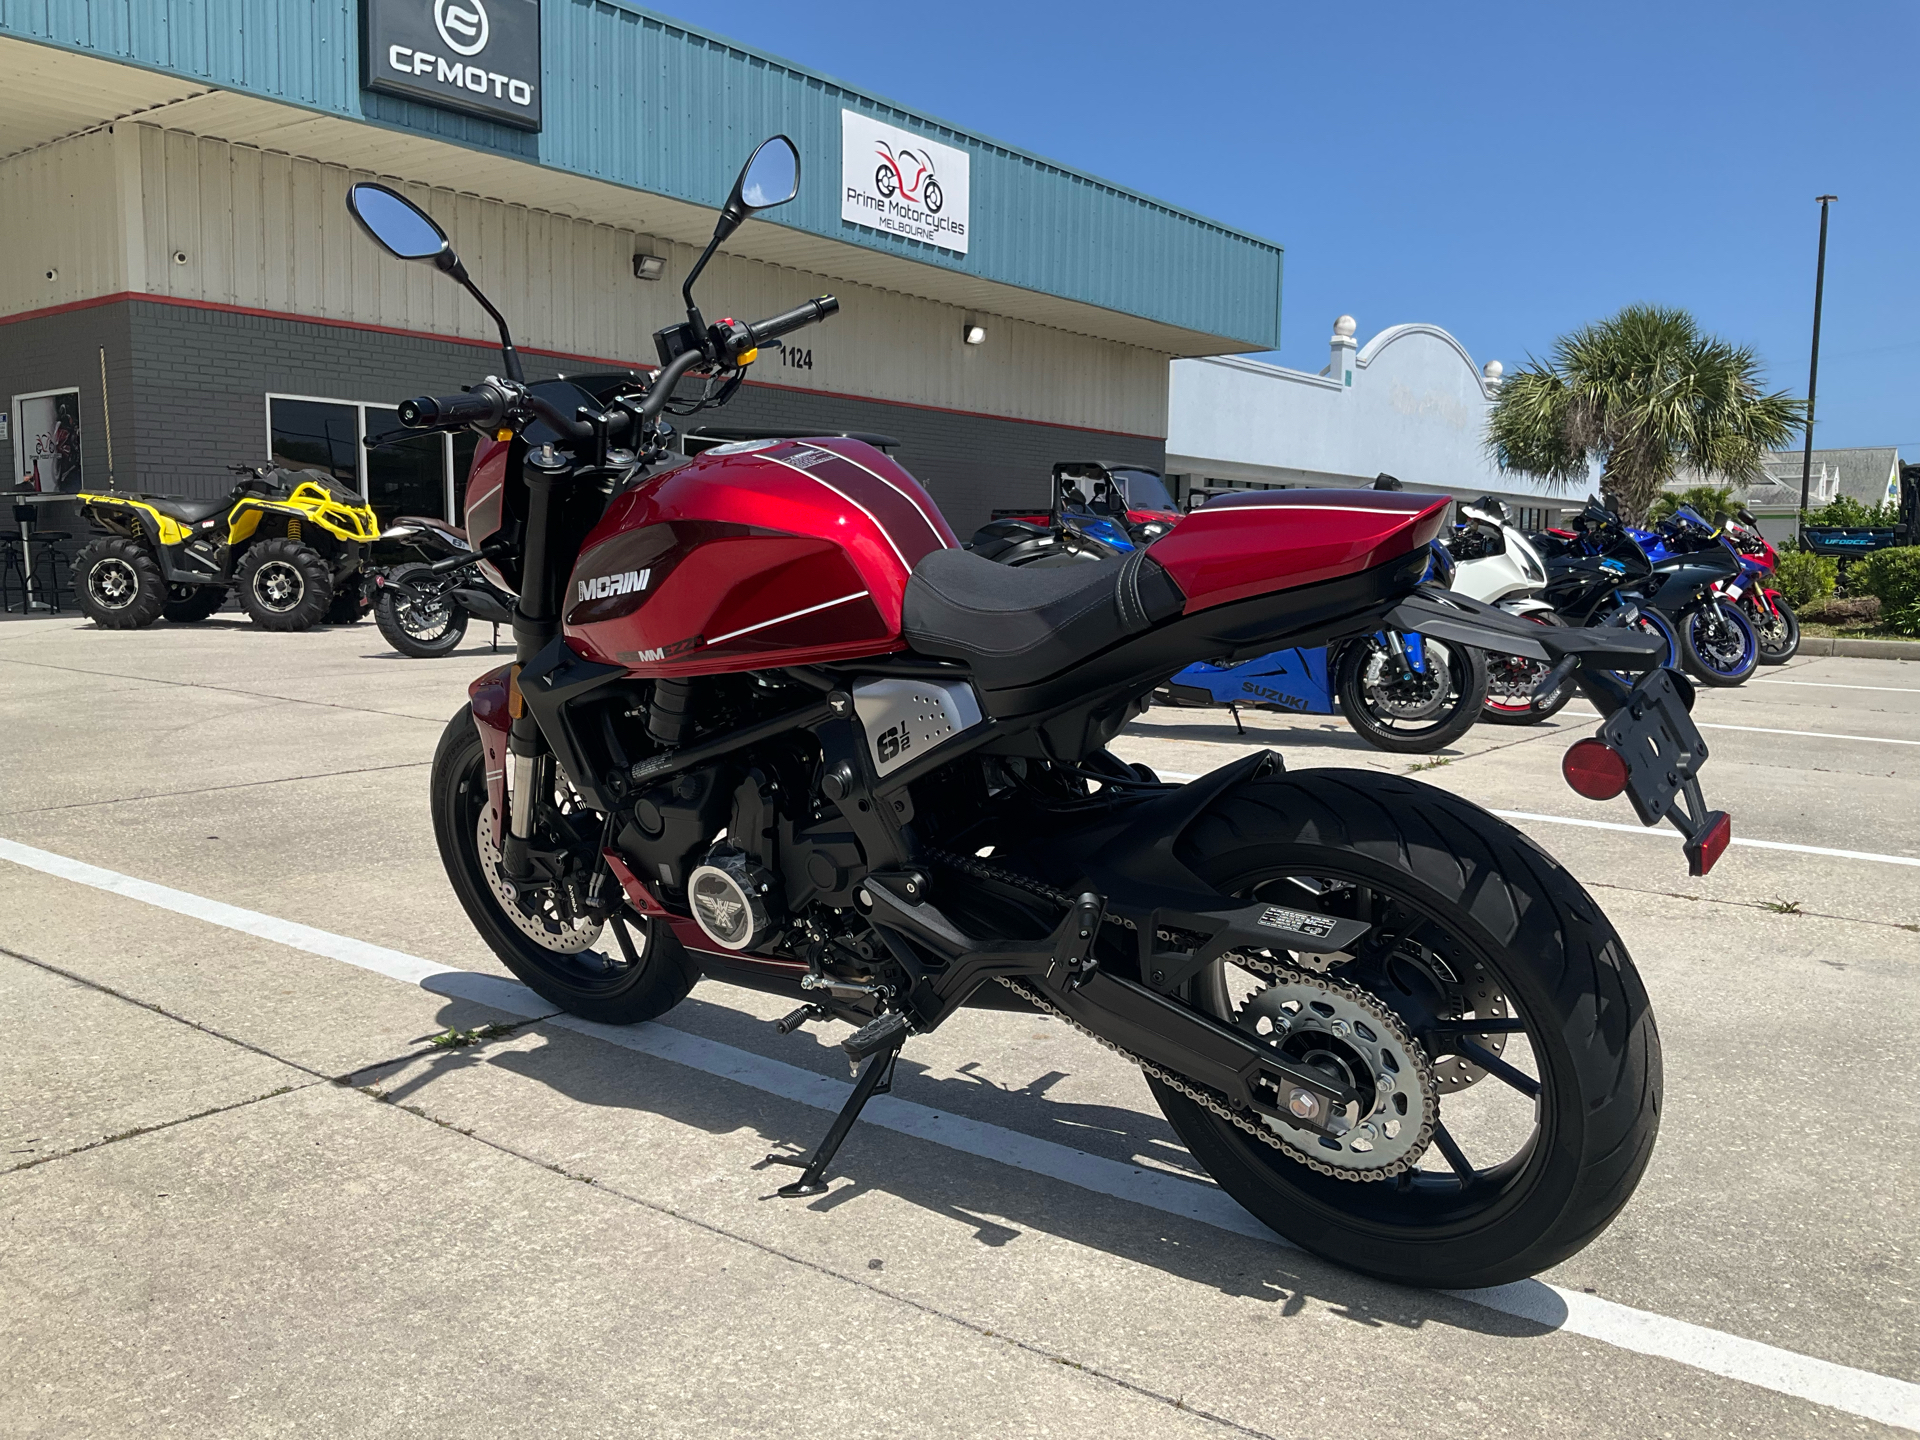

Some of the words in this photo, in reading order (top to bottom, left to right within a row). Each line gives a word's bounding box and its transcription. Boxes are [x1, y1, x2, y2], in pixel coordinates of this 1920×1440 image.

[389, 44, 532, 106] CFMOTO
[846, 187, 886, 213] Prime
[888, 199, 966, 236] Motorcycles
[879, 216, 935, 241] MELBOURNE
[780, 345, 813, 370] 1124
[578, 568, 651, 602] MORINI
[1241, 681, 1309, 711] SUZUKI
